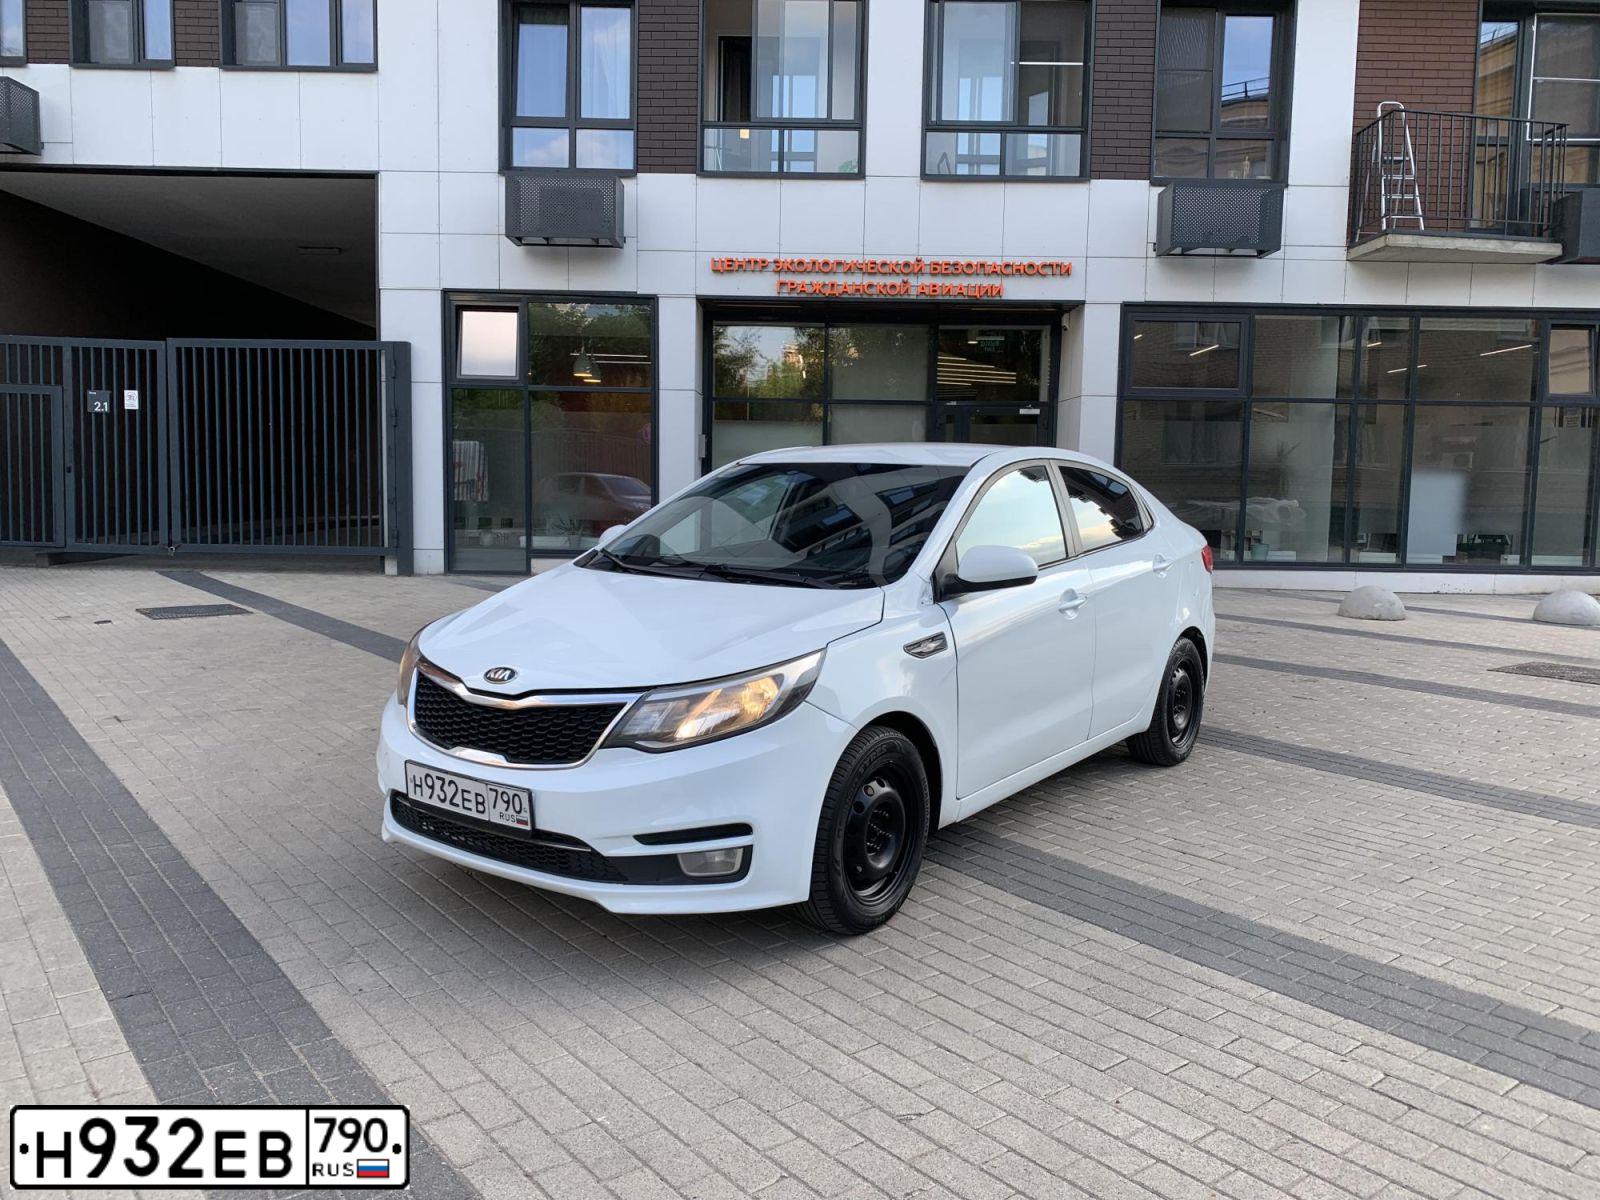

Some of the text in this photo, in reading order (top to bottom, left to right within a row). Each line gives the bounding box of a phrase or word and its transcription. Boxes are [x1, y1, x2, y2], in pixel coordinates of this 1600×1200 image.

[710, 256, 1072, 276] ЦЕНТР ЭКОЛОГИЧЕСКОЙ БЕЗОПАСНОСТИ
[776, 278, 1004, 298] ГРАЖДАНСКОЙ АВИАЦИИ
[486, 668, 511, 680] KIA
[489, 788, 522, 814] 790
[499, 812, 515, 823] RUS
